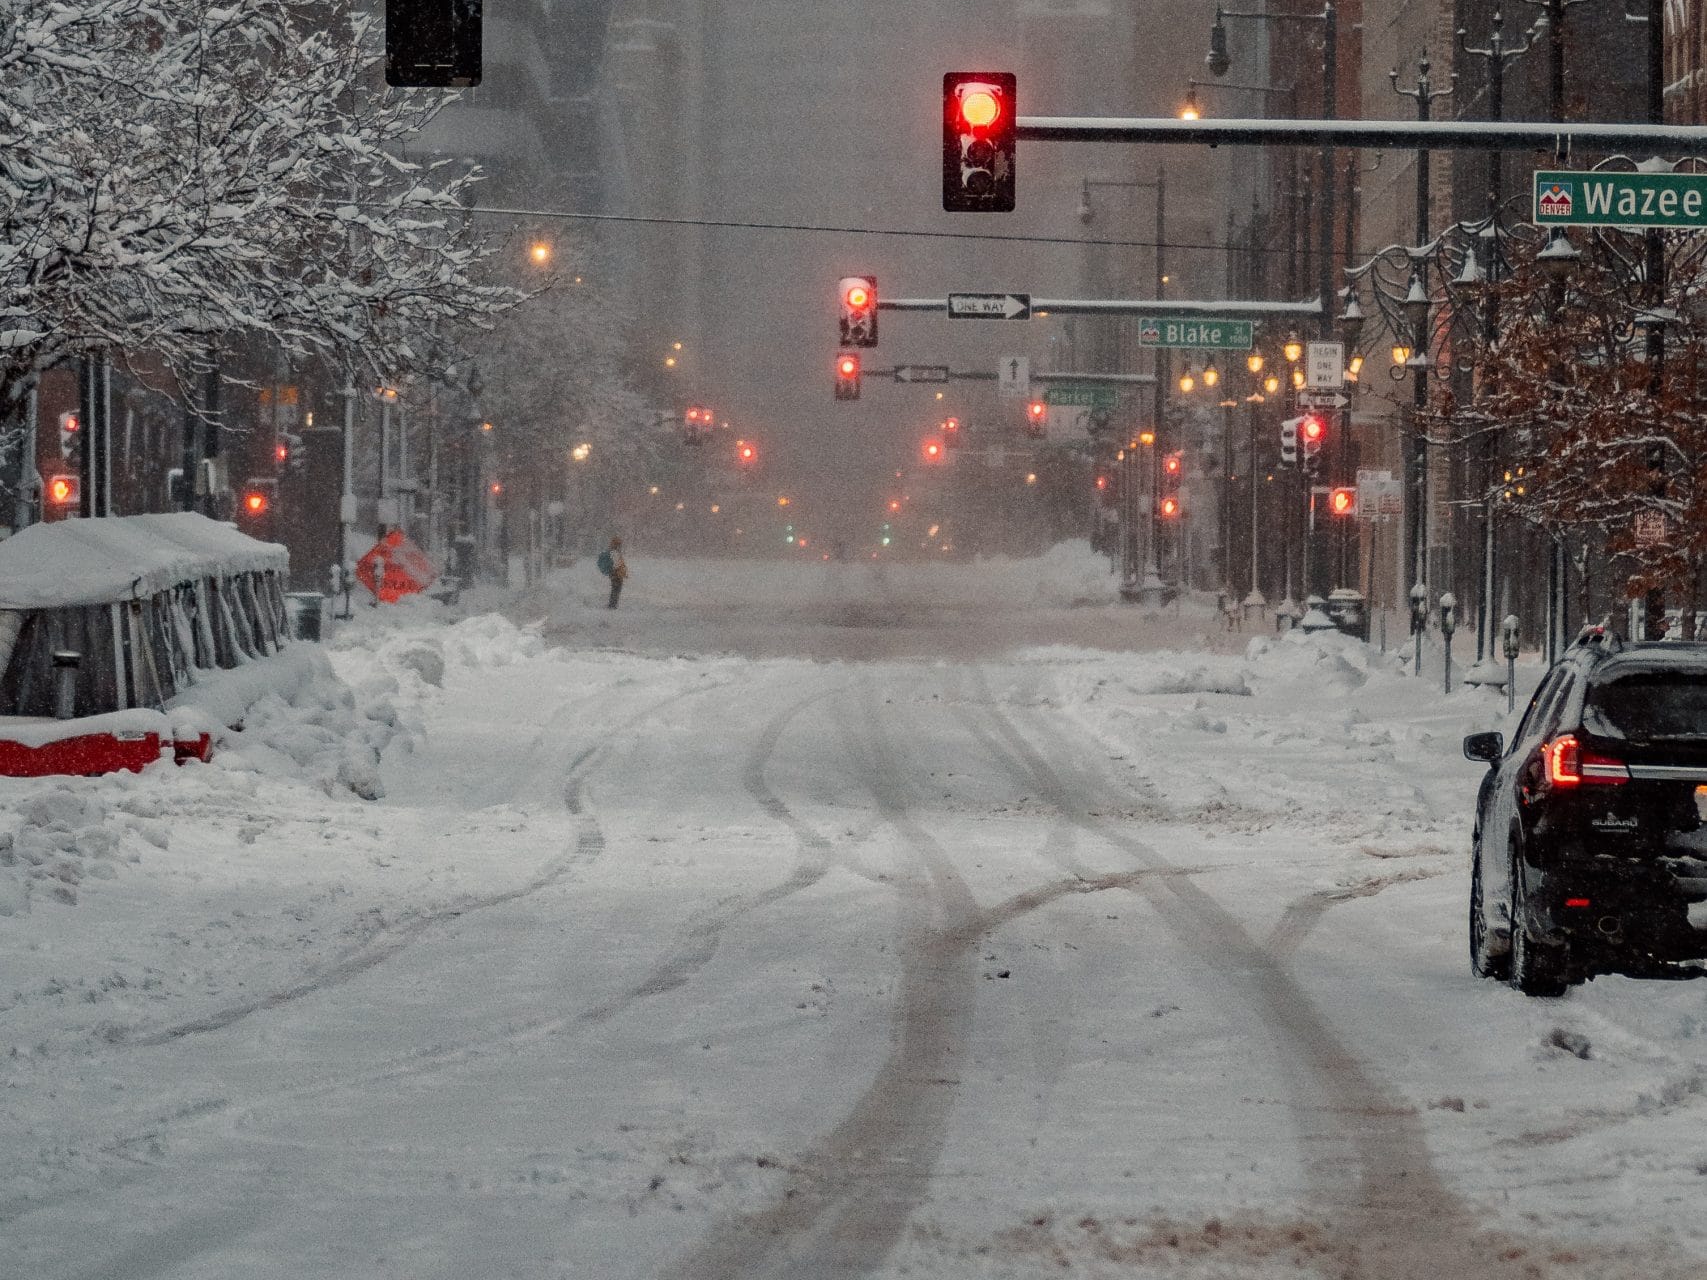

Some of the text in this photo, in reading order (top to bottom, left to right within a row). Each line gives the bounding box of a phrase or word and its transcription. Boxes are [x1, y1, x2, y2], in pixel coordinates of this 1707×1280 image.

[1583, 182, 1702, 216] Wazee
[1540, 204, 1571, 214] DENVER
[956, 301, 1005, 311] ONE WAY
[1167, 324, 1221, 343] Blake
[1317, 362, 1332, 370] ONE
